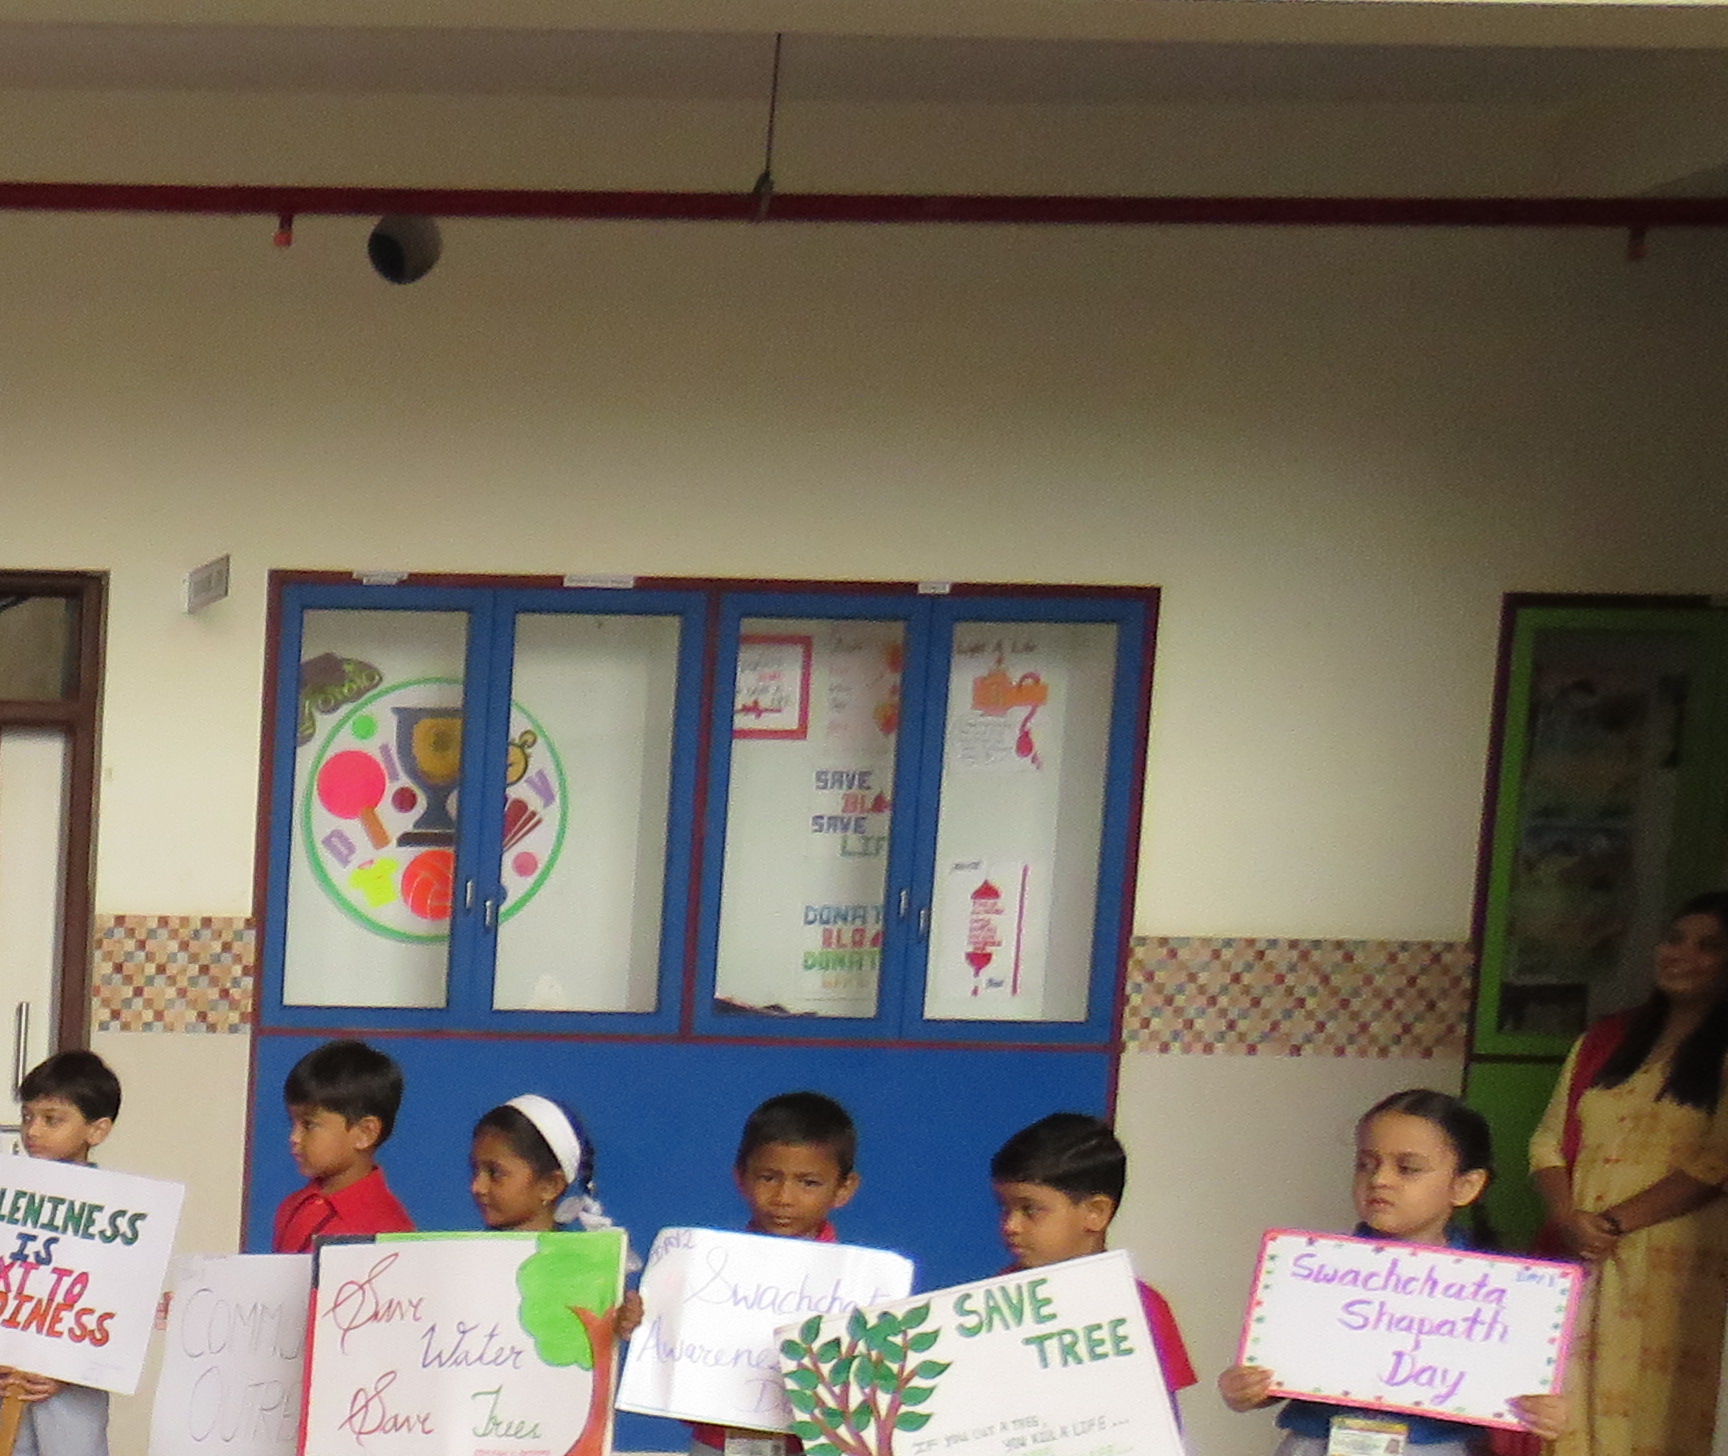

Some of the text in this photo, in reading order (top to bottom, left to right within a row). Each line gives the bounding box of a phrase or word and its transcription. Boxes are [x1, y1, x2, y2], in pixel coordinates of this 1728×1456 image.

[814, 770, 873, 791] SAVE
[810, 814, 868, 834] SAVE
[9, 1232, 60, 1266] IS
[46, 1266, 90, 1306] TO
[321, 1252, 425, 1355] Save
[1289, 1251, 1510, 1305] Swachchata
[952, 1277, 1058, 1338] SAVE
[1336, 1297, 1512, 1352] Shapath
[420, 1320, 527, 1370] Water
[1021, 1317, 1135, 1370] TREE
[1377, 1350, 1467, 1406] Day
[338, 1370, 436, 1446] Save
